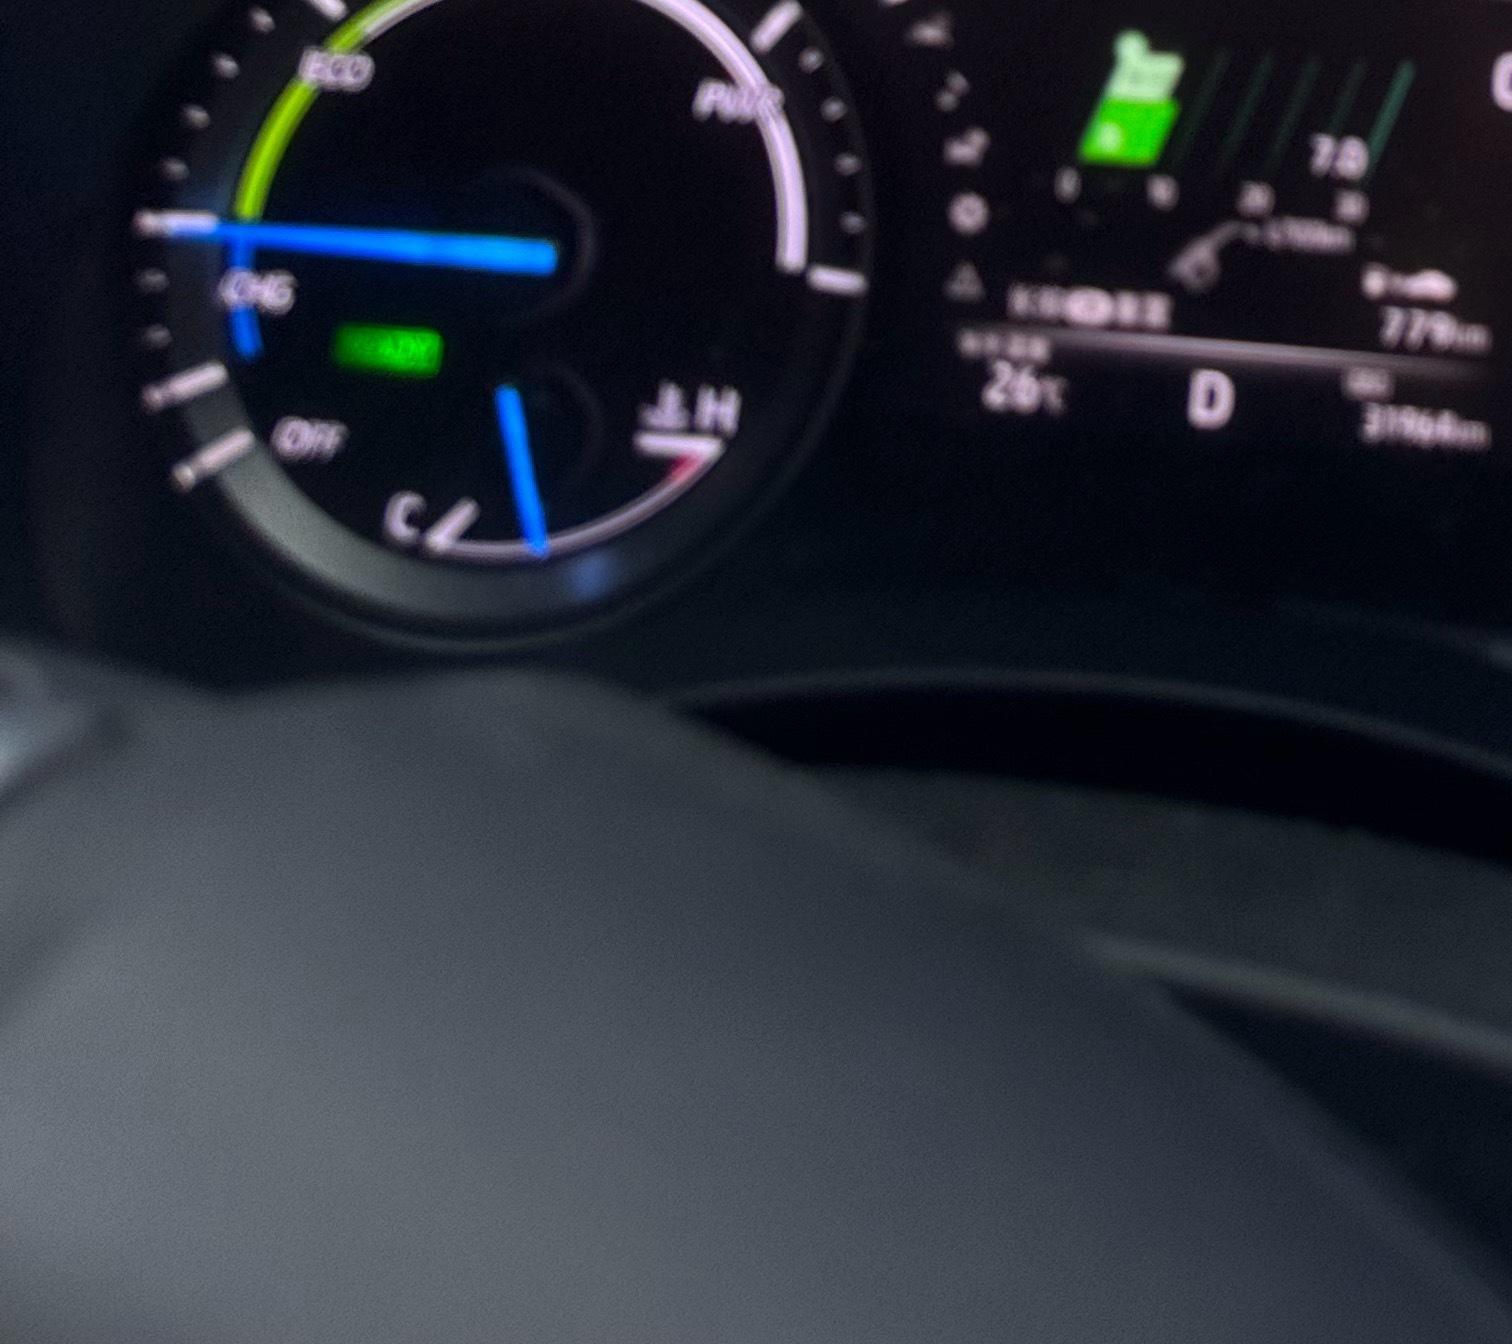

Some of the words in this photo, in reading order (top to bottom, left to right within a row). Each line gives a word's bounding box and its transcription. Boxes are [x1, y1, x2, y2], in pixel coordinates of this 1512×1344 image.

[695, 385, 742, 437] H
[1187, 368, 1236, 430] D
[271, 415, 349, 462] OFF
[384, 490, 426, 544] C
